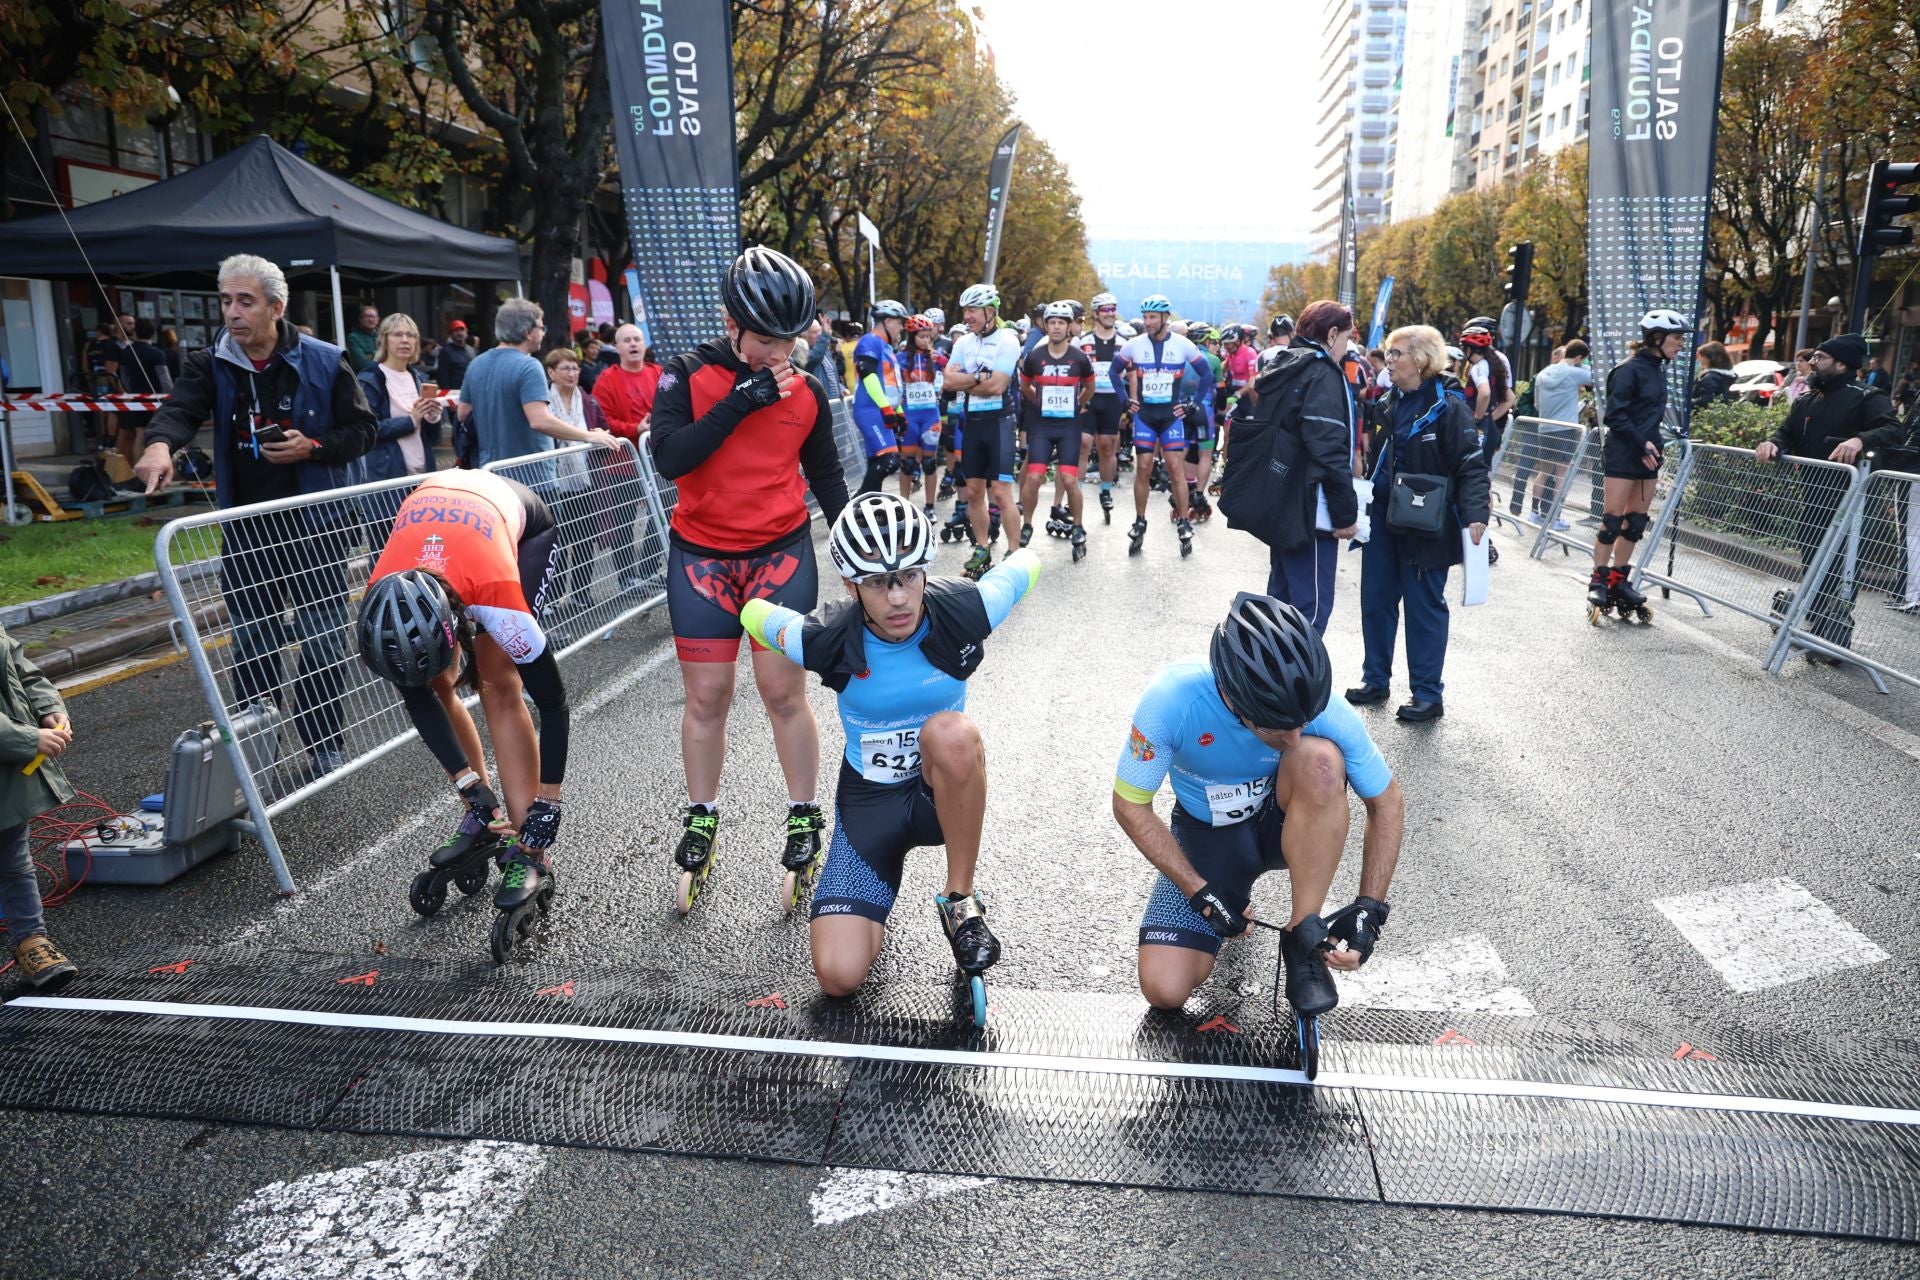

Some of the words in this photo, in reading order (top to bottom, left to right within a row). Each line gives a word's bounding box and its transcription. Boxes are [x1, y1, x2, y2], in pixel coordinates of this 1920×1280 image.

[1098, 264, 1170, 279] REALE
[1176, 265, 1243, 280] ARENA
[1145, 383, 1170, 392] 6077
[909, 391, 933, 399] 6043
[1047, 396, 1069, 405] 6114
[830, 541, 845, 565] LAZER
[1210, 791, 1234, 802] salto
[818, 903, 852, 914] EUSKAL
[1145, 930, 1178, 942] EUSKAL
